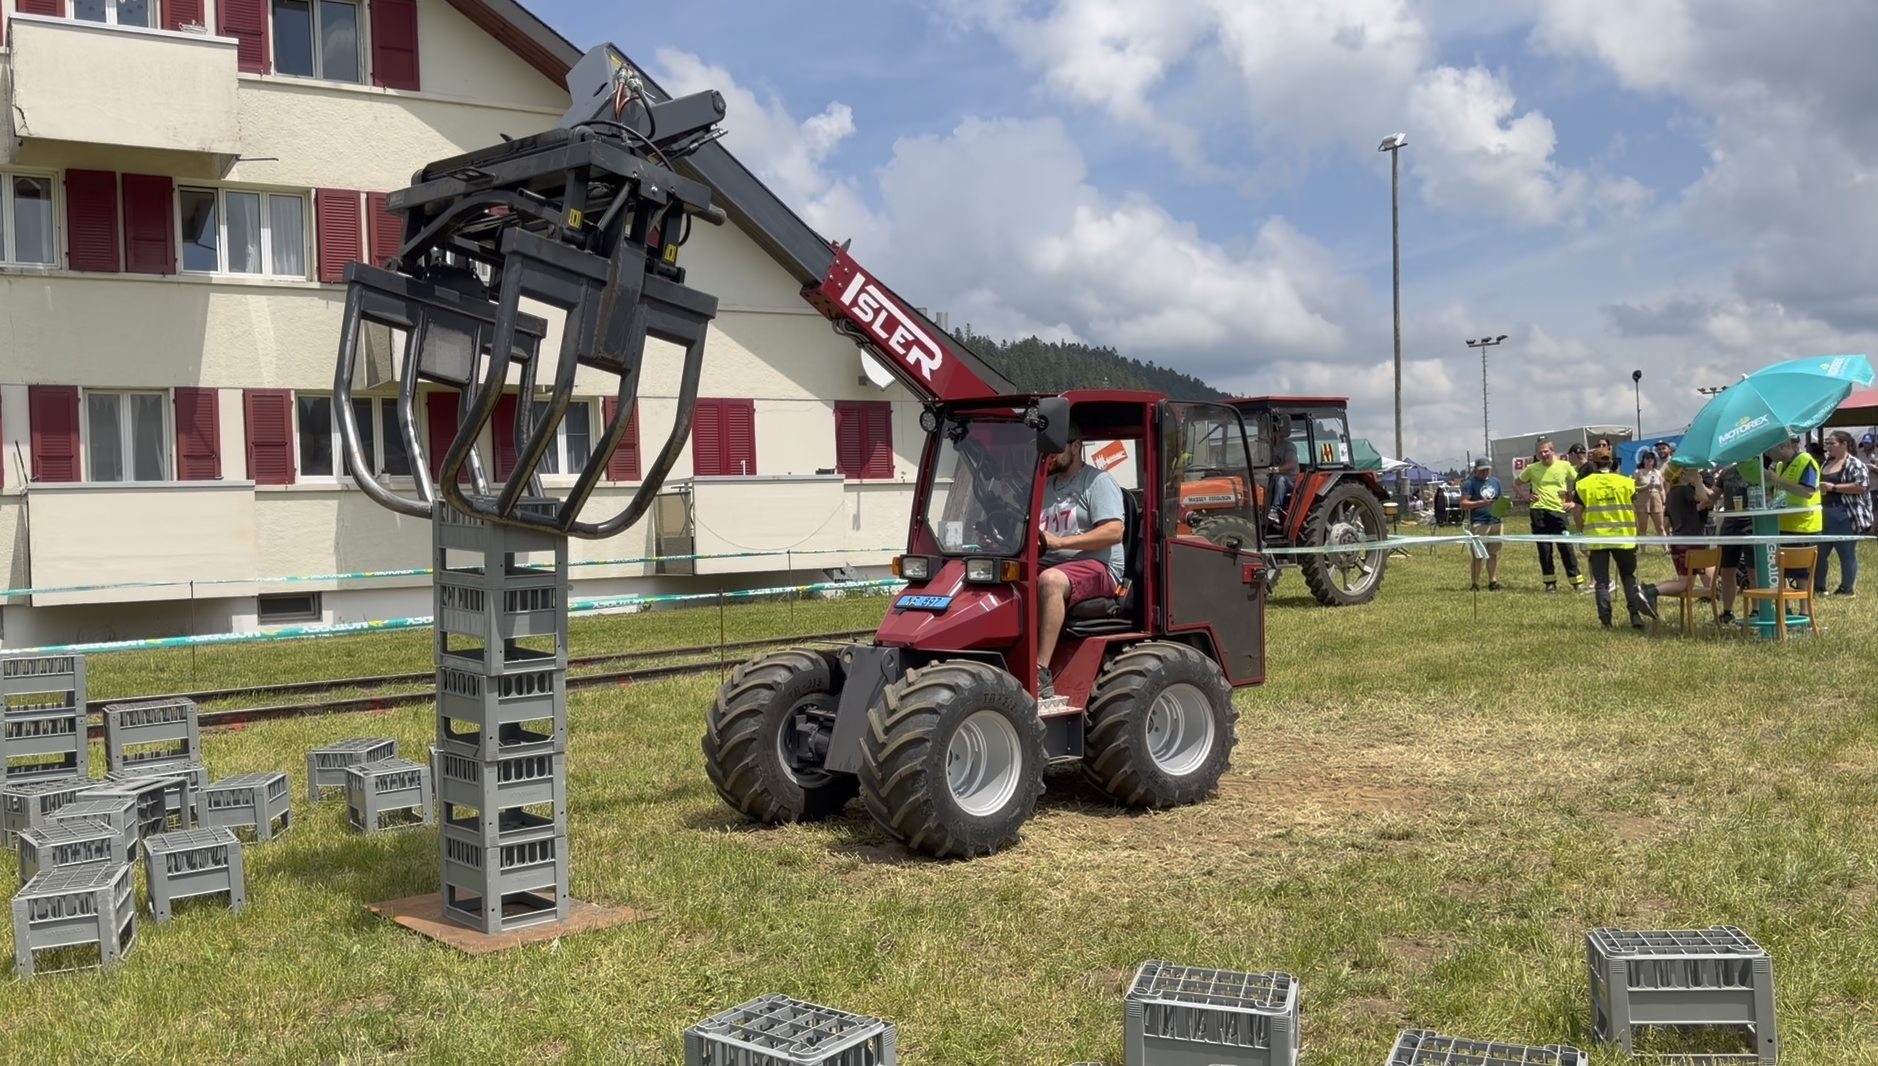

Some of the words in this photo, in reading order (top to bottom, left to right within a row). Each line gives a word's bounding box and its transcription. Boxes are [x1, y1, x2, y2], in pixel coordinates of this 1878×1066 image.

[840, 272, 943, 382] ISLER
[1718, 413, 1770, 444] MOTOREX
[1041, 509, 1072, 532] 117
